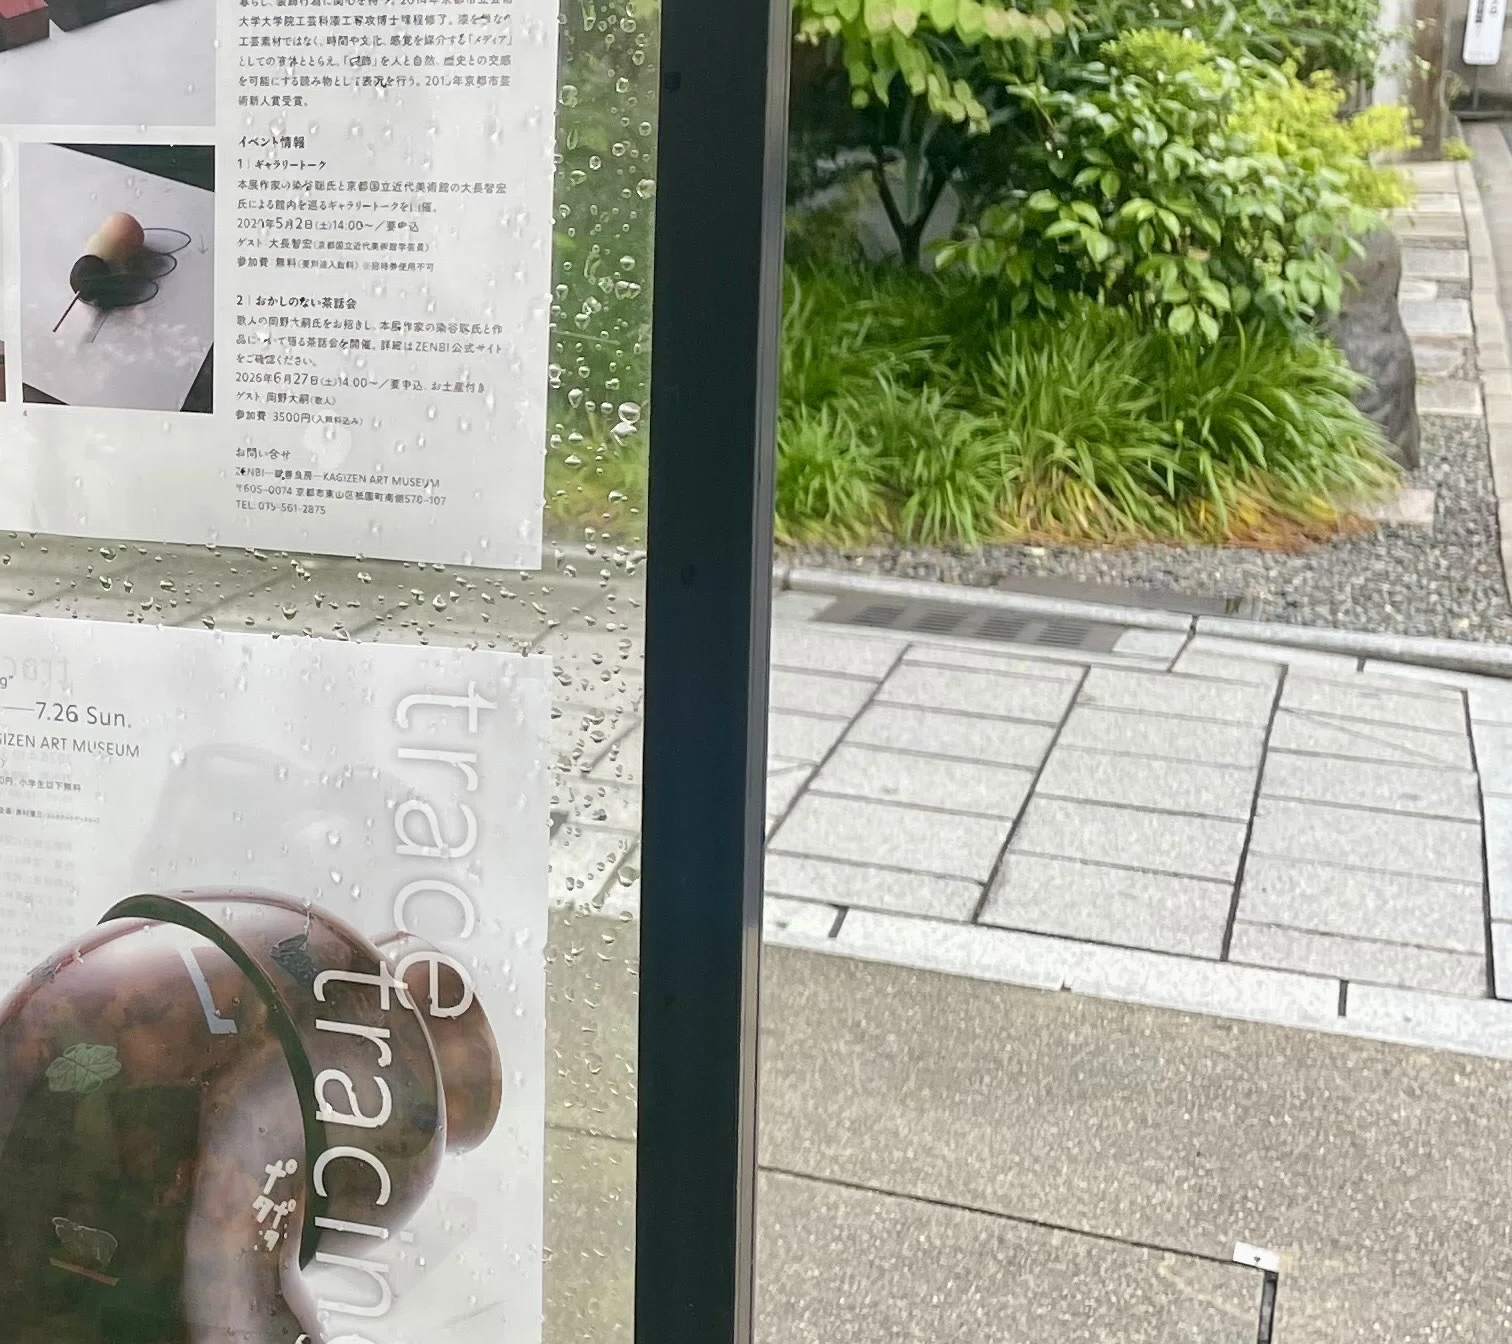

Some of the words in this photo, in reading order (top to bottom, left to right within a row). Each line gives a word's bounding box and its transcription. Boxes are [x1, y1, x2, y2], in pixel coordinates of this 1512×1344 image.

[87, 706, 132, 729] Sun.
[40, 735, 68, 752] ART
[393, 680, 497, 1019] trace
